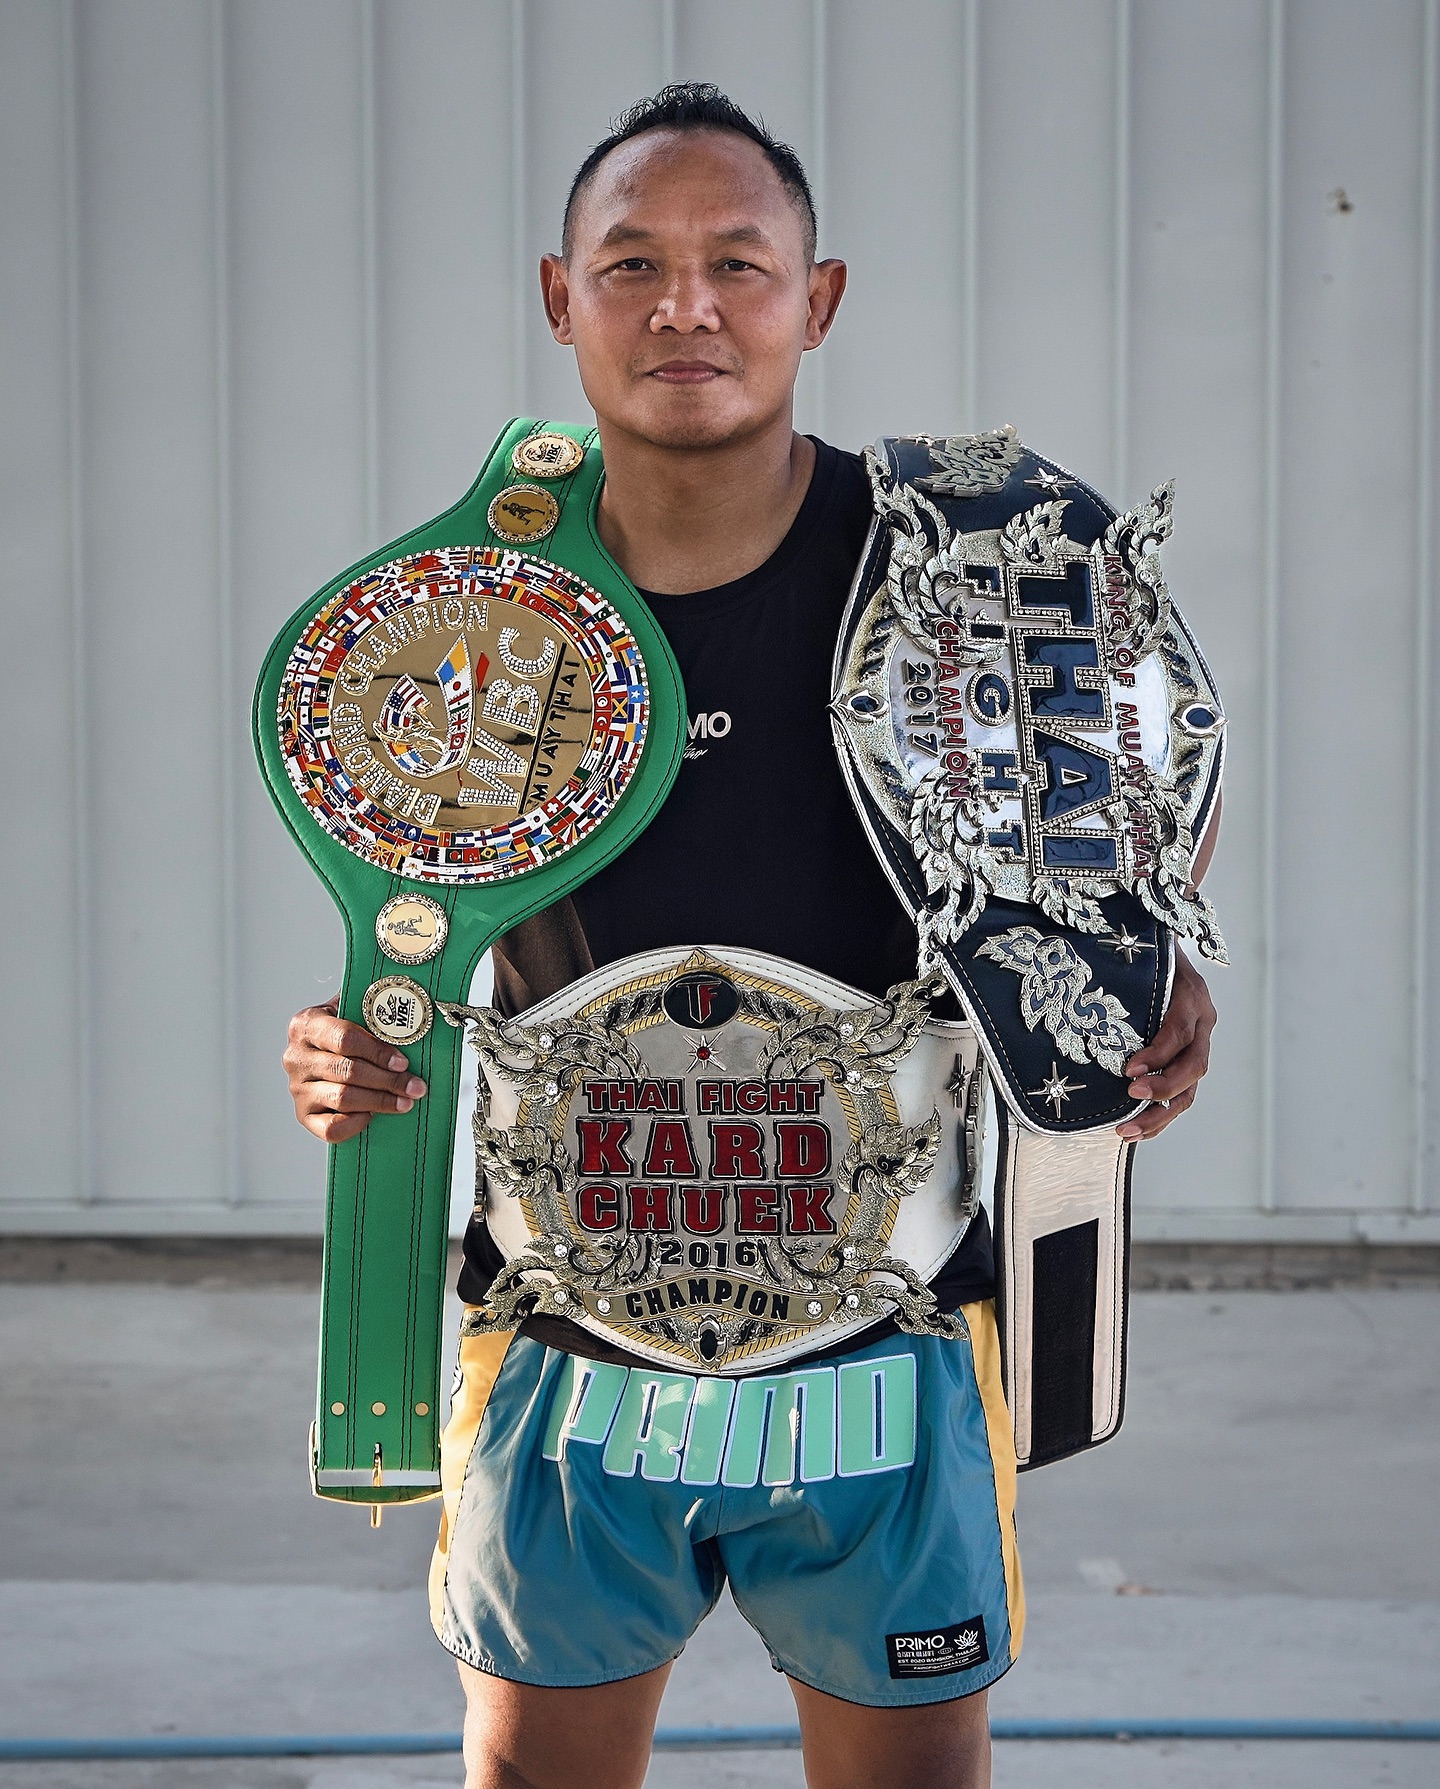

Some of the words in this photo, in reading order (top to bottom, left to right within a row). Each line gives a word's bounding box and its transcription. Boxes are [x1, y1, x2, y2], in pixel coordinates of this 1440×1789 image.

[543, 444, 561, 464] WBC
[1103, 555, 1131, 632] KING
[340, 599, 489, 696] CHAMPION
[1114, 647, 1136, 688] OF
[458, 626, 558, 808] WBC
[901, 659, 939, 759] 2017
[935, 619, 971, 801] CHAMPION
[958, 560, 1028, 864] FIGHT
[1006, 552, 1127, 879] THAI
[332, 702, 441, 826] DIAMOND
[1115, 702, 1150, 798] MUAY
[1128, 809, 1152, 878] THAI
[396, 997, 410, 1027] WBC
[582, 1079, 685, 1113] THAI
[697, 1079, 824, 1115] FIGHT
[576, 1116, 834, 1181] KARD
[576, 1182, 839, 1236] CHUEK
[661, 1239, 757, 1269] 2016
[626, 1284, 790, 1322] CHAMPION
[542, 1352, 919, 1489] PRIMO
[895, 1634, 945, 1651] PRIMO
